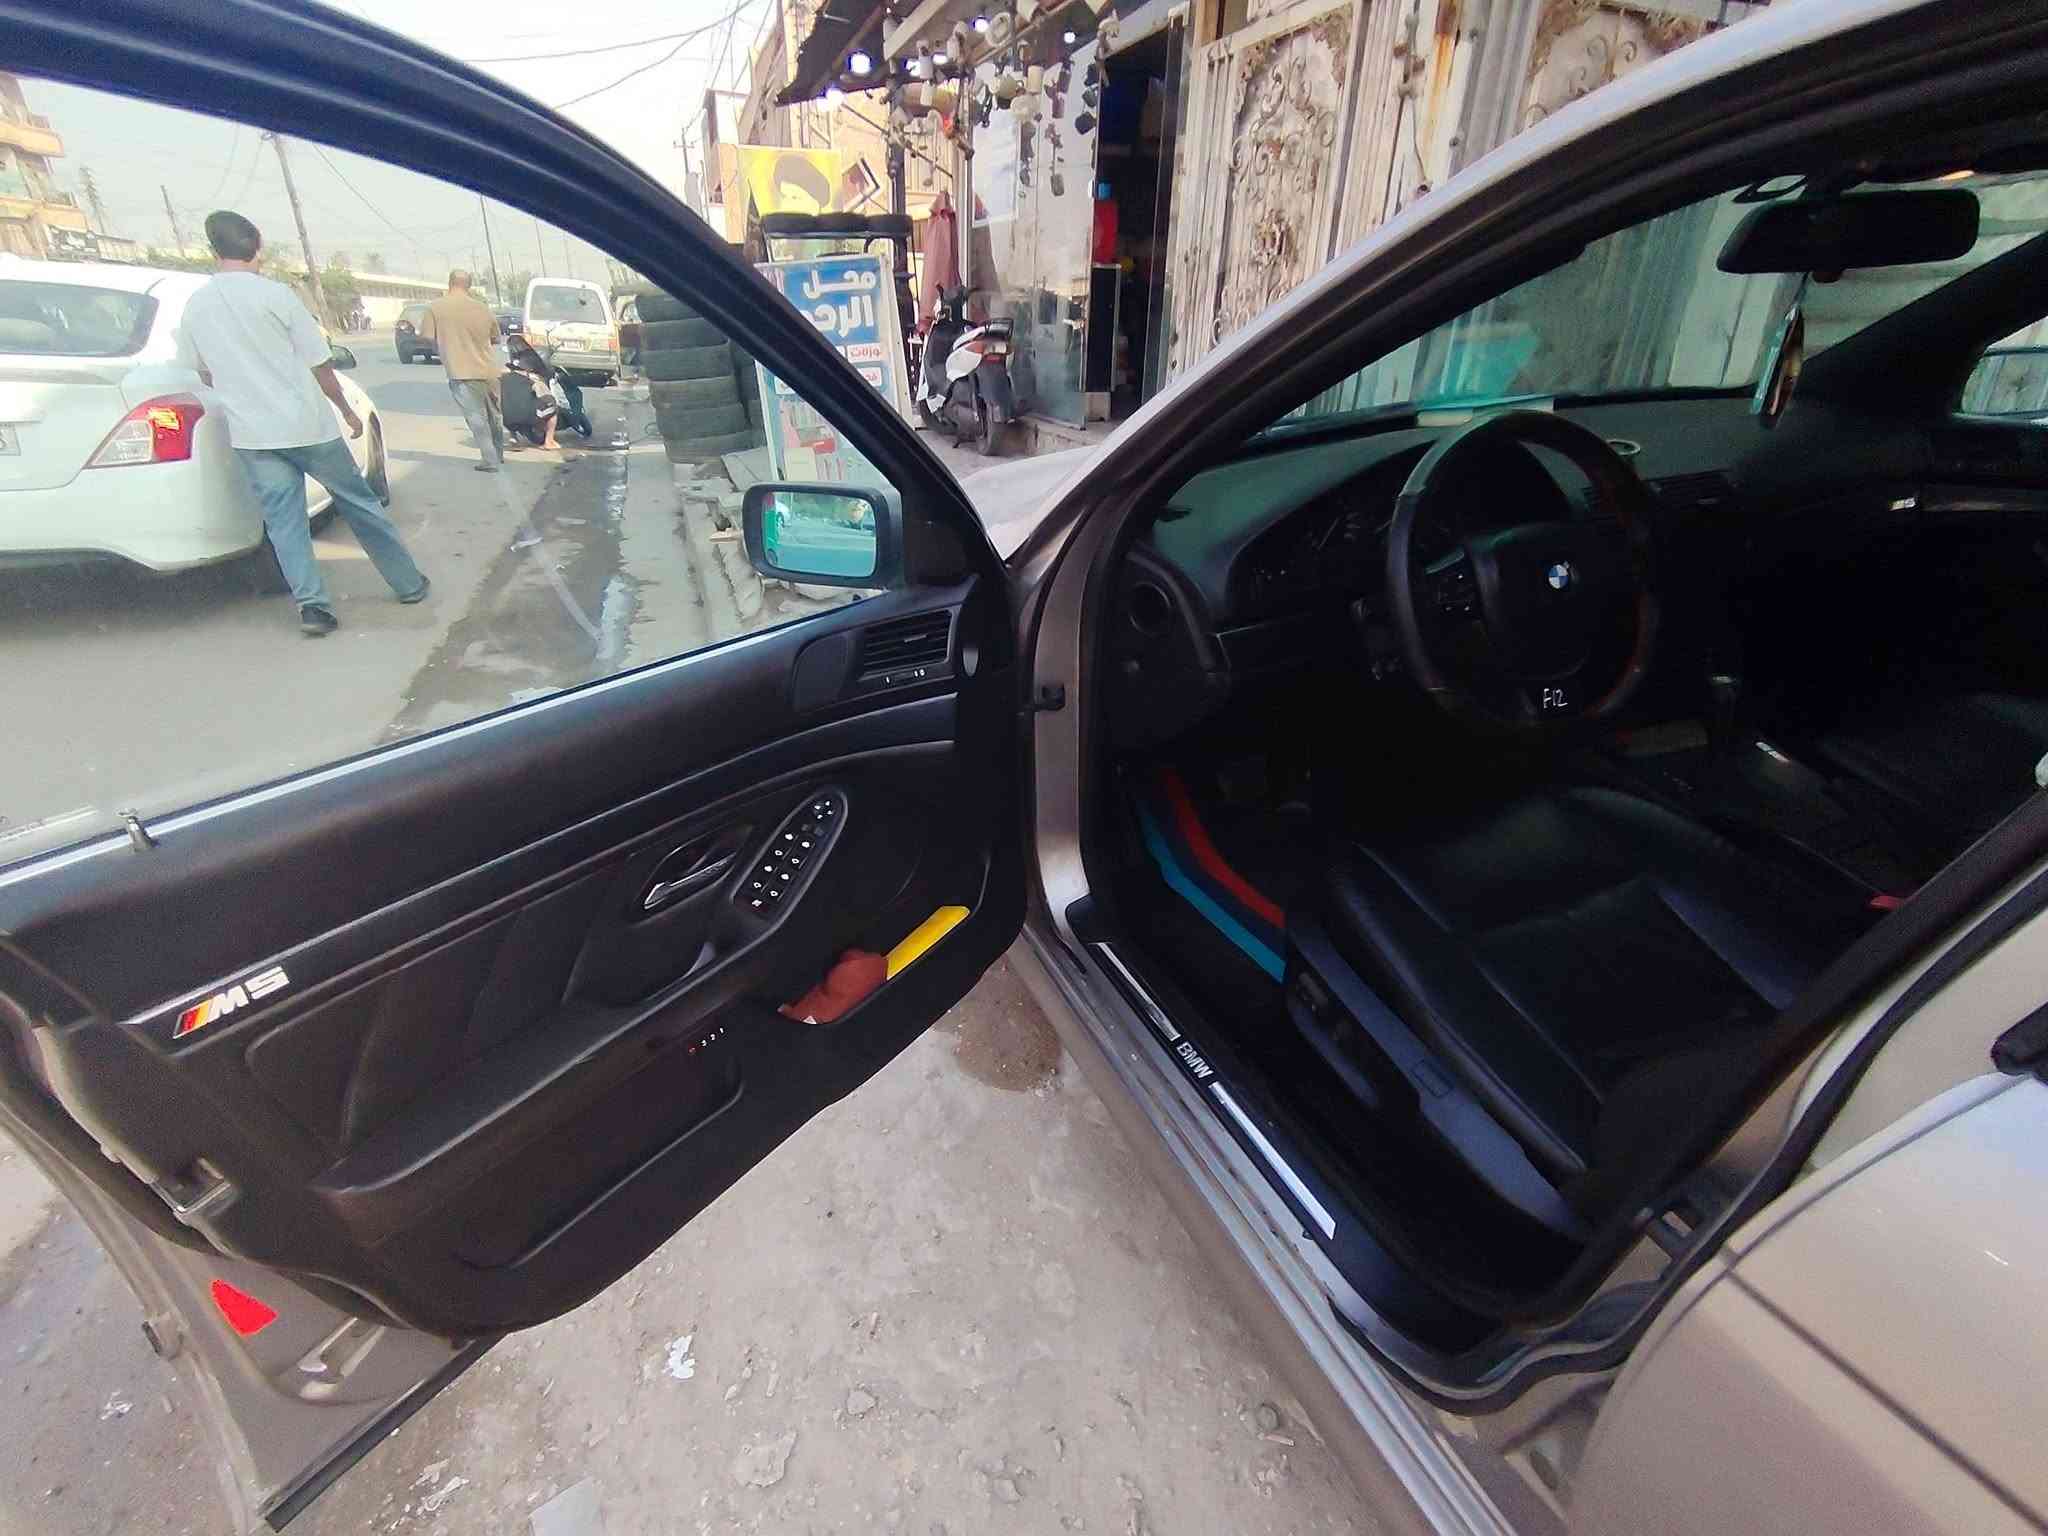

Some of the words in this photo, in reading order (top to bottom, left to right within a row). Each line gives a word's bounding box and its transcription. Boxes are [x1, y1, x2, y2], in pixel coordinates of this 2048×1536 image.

[803, 270, 877, 299] محل
[800, 295, 875, 338] الرح
[1176, 1041, 1214, 1079] BMW
